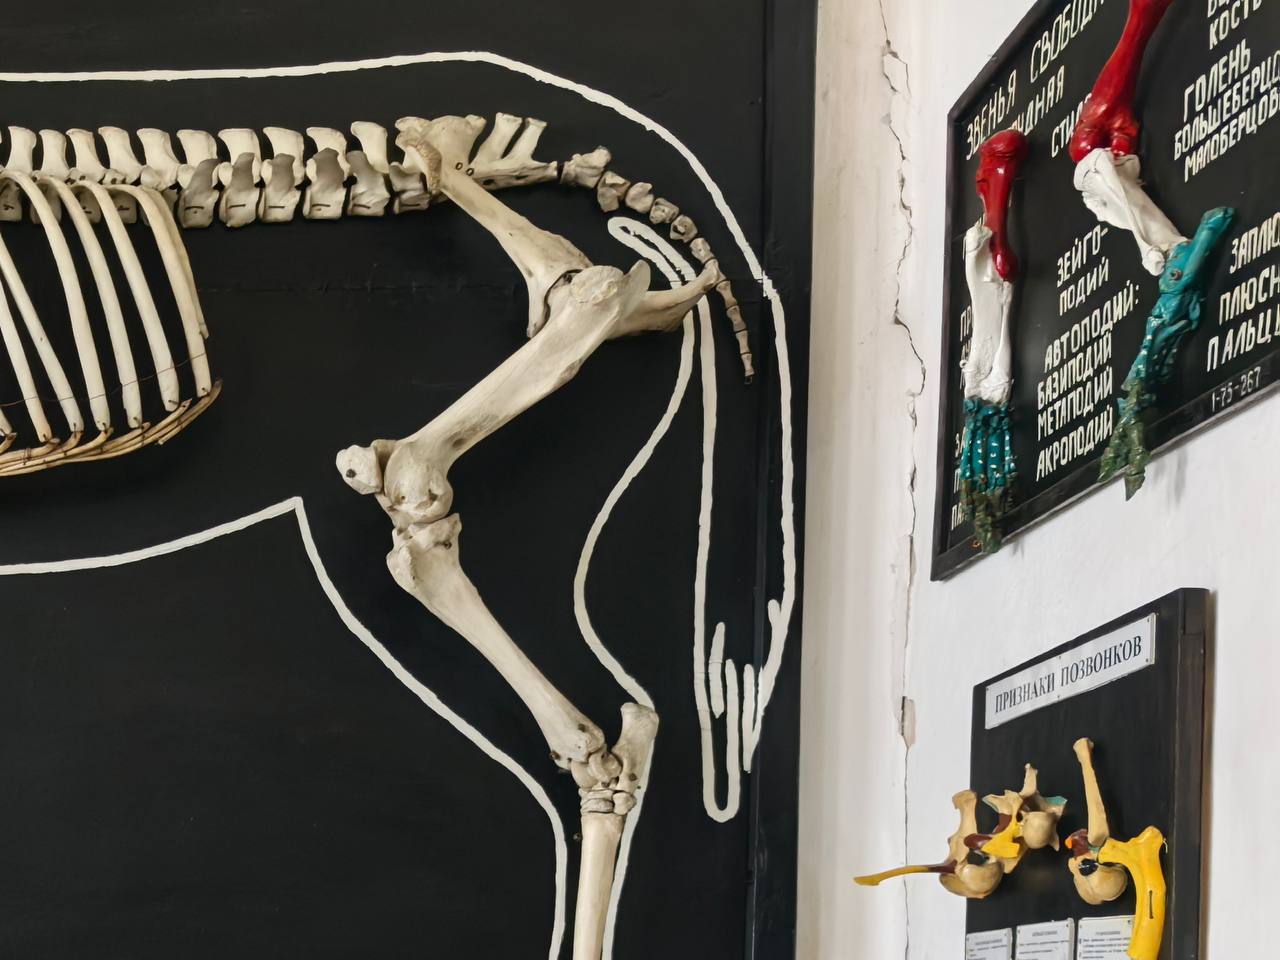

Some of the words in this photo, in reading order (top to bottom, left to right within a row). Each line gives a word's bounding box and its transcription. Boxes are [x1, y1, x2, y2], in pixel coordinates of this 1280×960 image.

[966, 69, 1017, 161] ЗВЕНЬЯ
[1183, 38, 1251, 123] ГОЛЕНЬ
[1056, 225, 1109, 288] ЗЕЙГО-
[1059, 256, 1109, 316] ПОДИЙ
[1044, 280, 1139, 373] АВТОПОДИЙ:
[1037, 331, 1112, 410] БАЗИПОДИЙ
[1037, 366, 1113, 441] МЕТАПОДИЙ
[1211, 366, 1262, 412] 1-75-267
[1035, 405, 1113, 482] АКРОПОДИЙ
[995, 672, 1055, 714] ПРИЗНАКИ
[1060, 635, 1142, 687] ПОЗВОНКОВ
